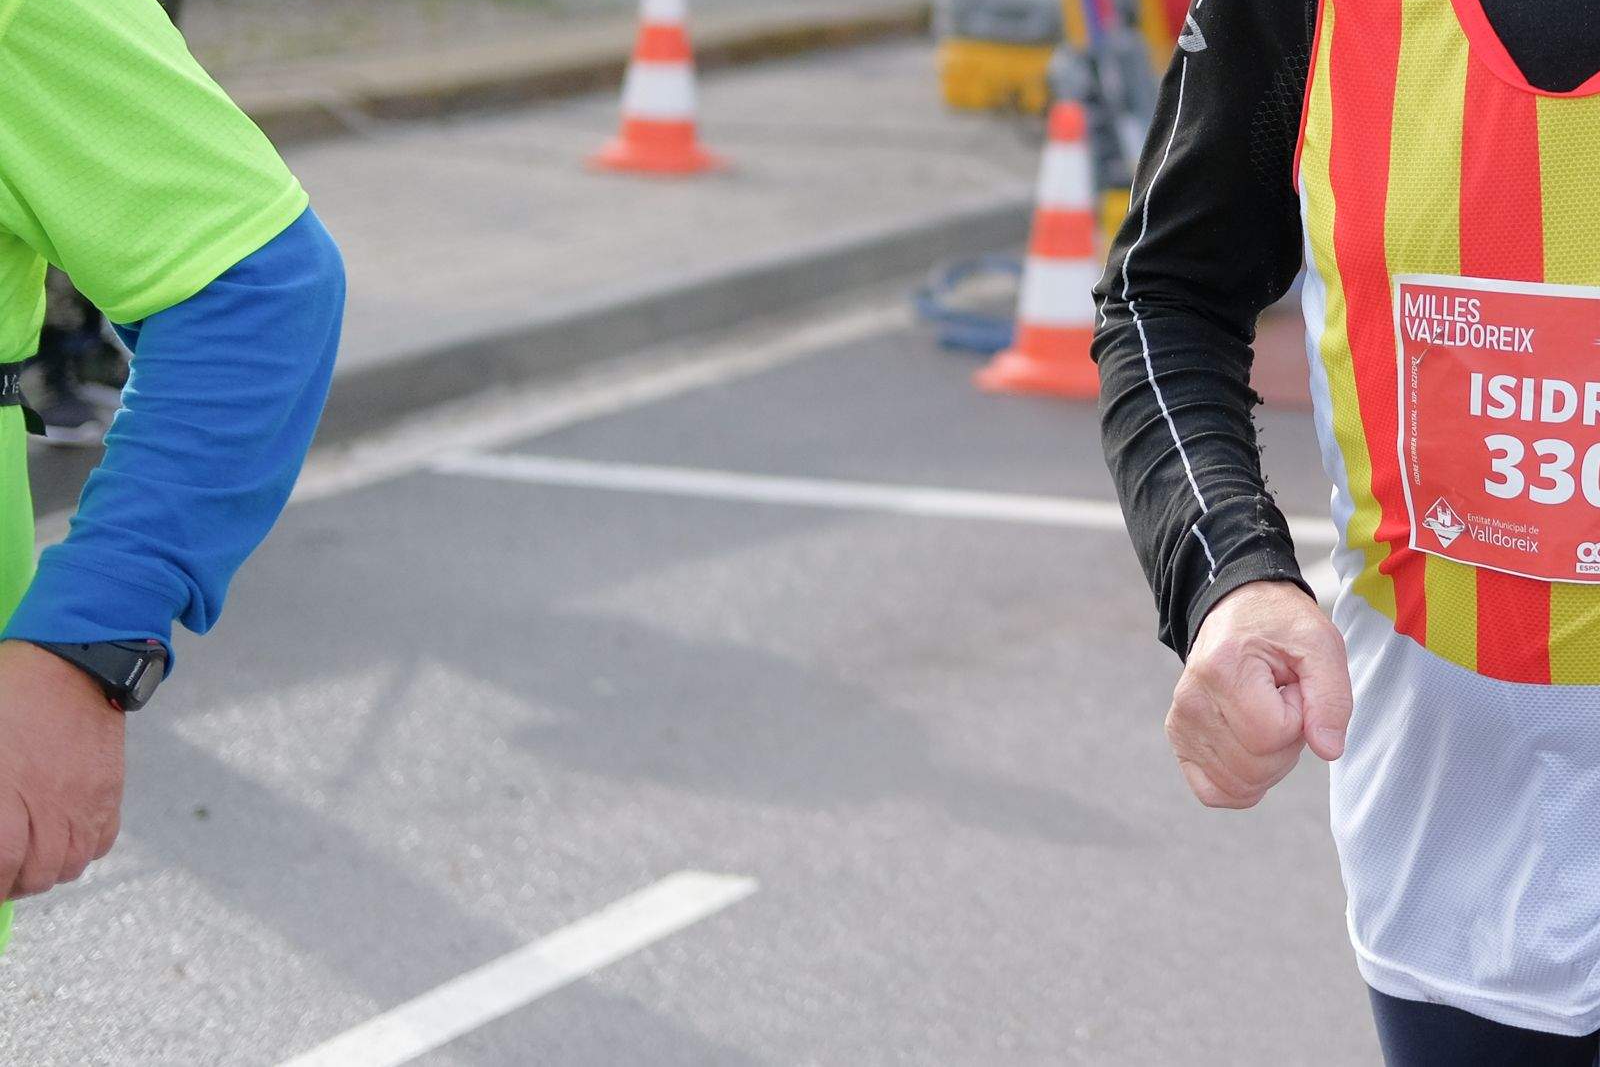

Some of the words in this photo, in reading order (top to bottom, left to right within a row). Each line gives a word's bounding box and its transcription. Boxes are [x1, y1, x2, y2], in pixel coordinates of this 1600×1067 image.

[1404, 292, 1481, 323] MILLES
[1404, 316, 1535, 353] VALLDOREIX
[1467, 513, 1491, 525] Entitat
[1492, 518, 1527, 533] Municipal
[1528, 525, 1540, 535] de
[1467, 523, 1539, 553] Valldoreix
